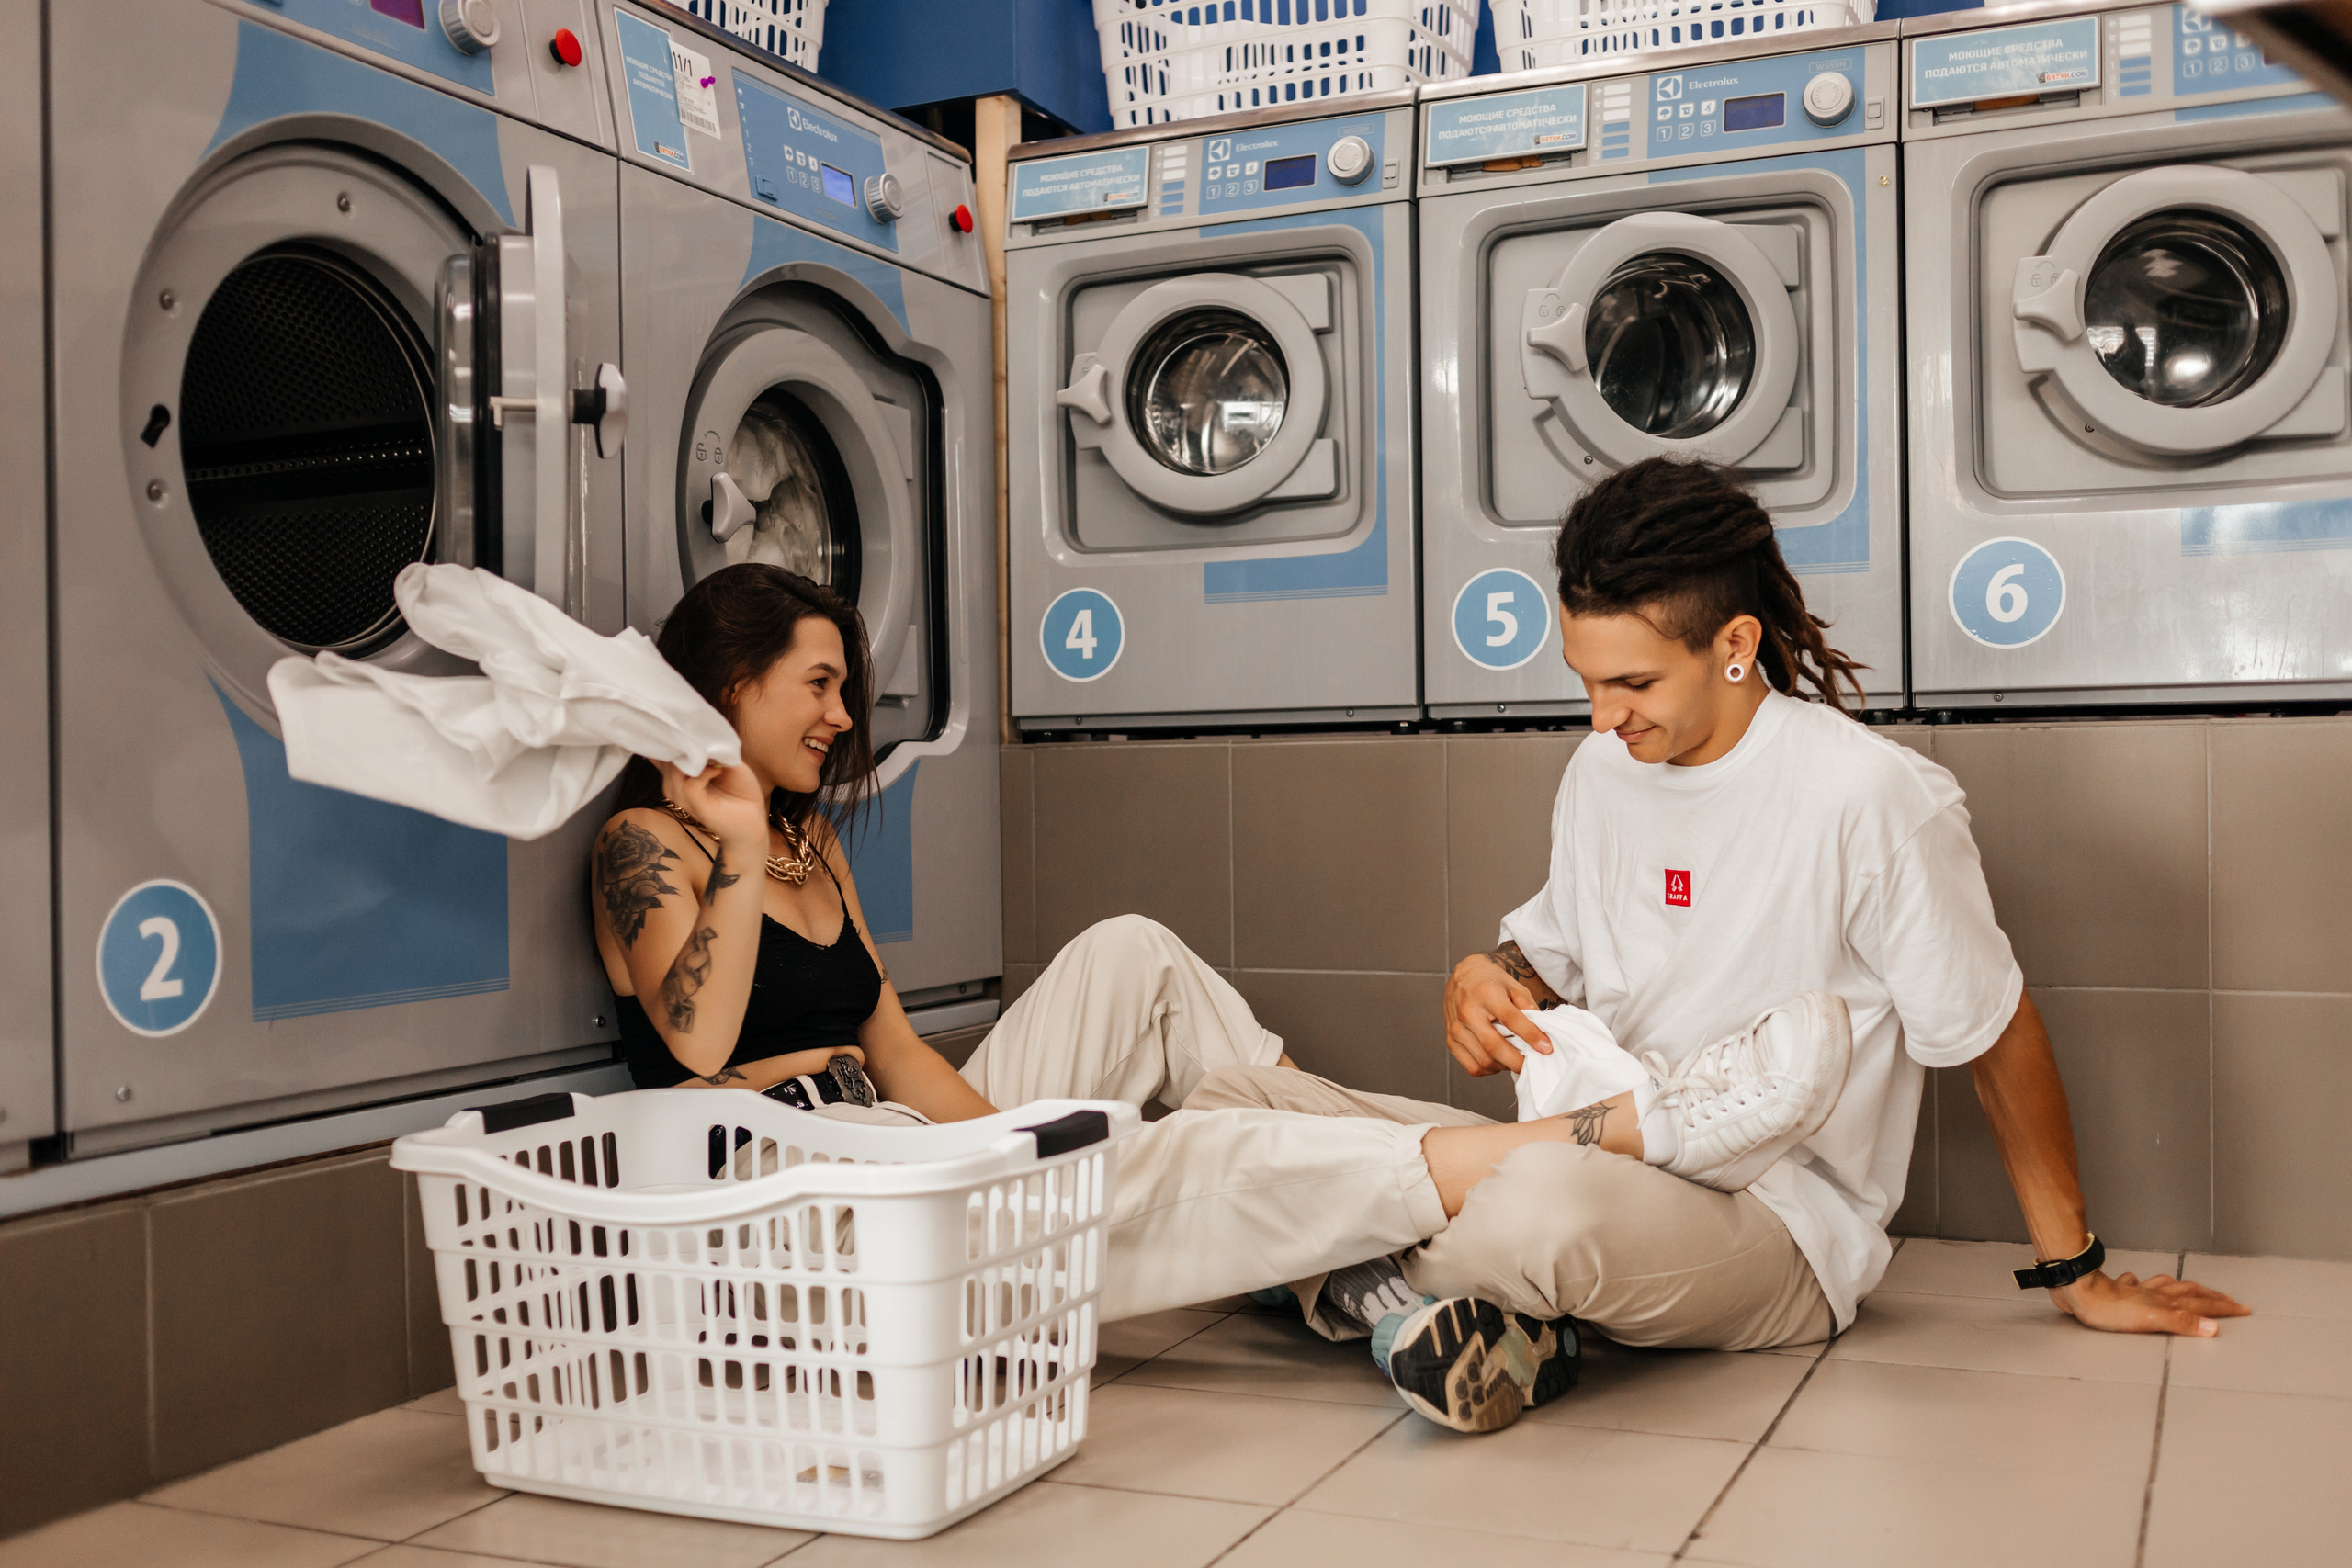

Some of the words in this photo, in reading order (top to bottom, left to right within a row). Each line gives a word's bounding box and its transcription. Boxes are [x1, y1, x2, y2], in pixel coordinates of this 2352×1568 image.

[1949, 47, 2001, 62] МОЮЩИЕ
[2004, 39, 2063, 54] СРЕДСТВА
[673, 51, 693, 77] 11/1
[1925, 63, 1987, 79] ПОДАЮТСЯ
[1990, 50, 2087, 70] АВТОМАТИЧЕСКИ
[2189, 63, 2195, 74] 1
[2213, 61, 2223, 72] 2
[2239, 57, 2249, 68] 3
[1689, 77, 1739, 90] Electrolux
[1459, 110, 1504, 124] МОЮЩИЕ
[1506, 104, 1556, 118] СРЕДСТВА
[802, 118, 839, 143] Electrolux
[1439, 126, 1491, 140] ПОДАЮТСЯ
[1492, 115, 1577, 132] АВТОМАТИЧЕСКИ
[1661, 129, 1667, 140] 1
[1681, 126, 1690, 137] 2
[1703, 123, 1712, 134] 3
[1236, 140, 1279, 152] Electrolux
[790, 170, 795, 180] 1
[802, 175, 808, 186] 2
[813, 179, 820, 190] 3
[1040, 170, 1079, 183] МОЮЩИЕ
[1080, 164, 1123, 177] СРЕДСТВА
[1022, 184, 1068, 197] ПОДАЮТСЯ
[1069, 174, 1140, 190] АВТОМАТИЧЕСКИ
[1210, 187, 1216, 197] 1
[1227, 185, 1236, 195] 2
[1246, 182, 1254, 193] 3
[1985, 563, 2029, 623] 6
[1486, 591, 1518, 647] 5
[1066, 609, 1097, 659] 4
[139, 916, 183, 1001] 2
